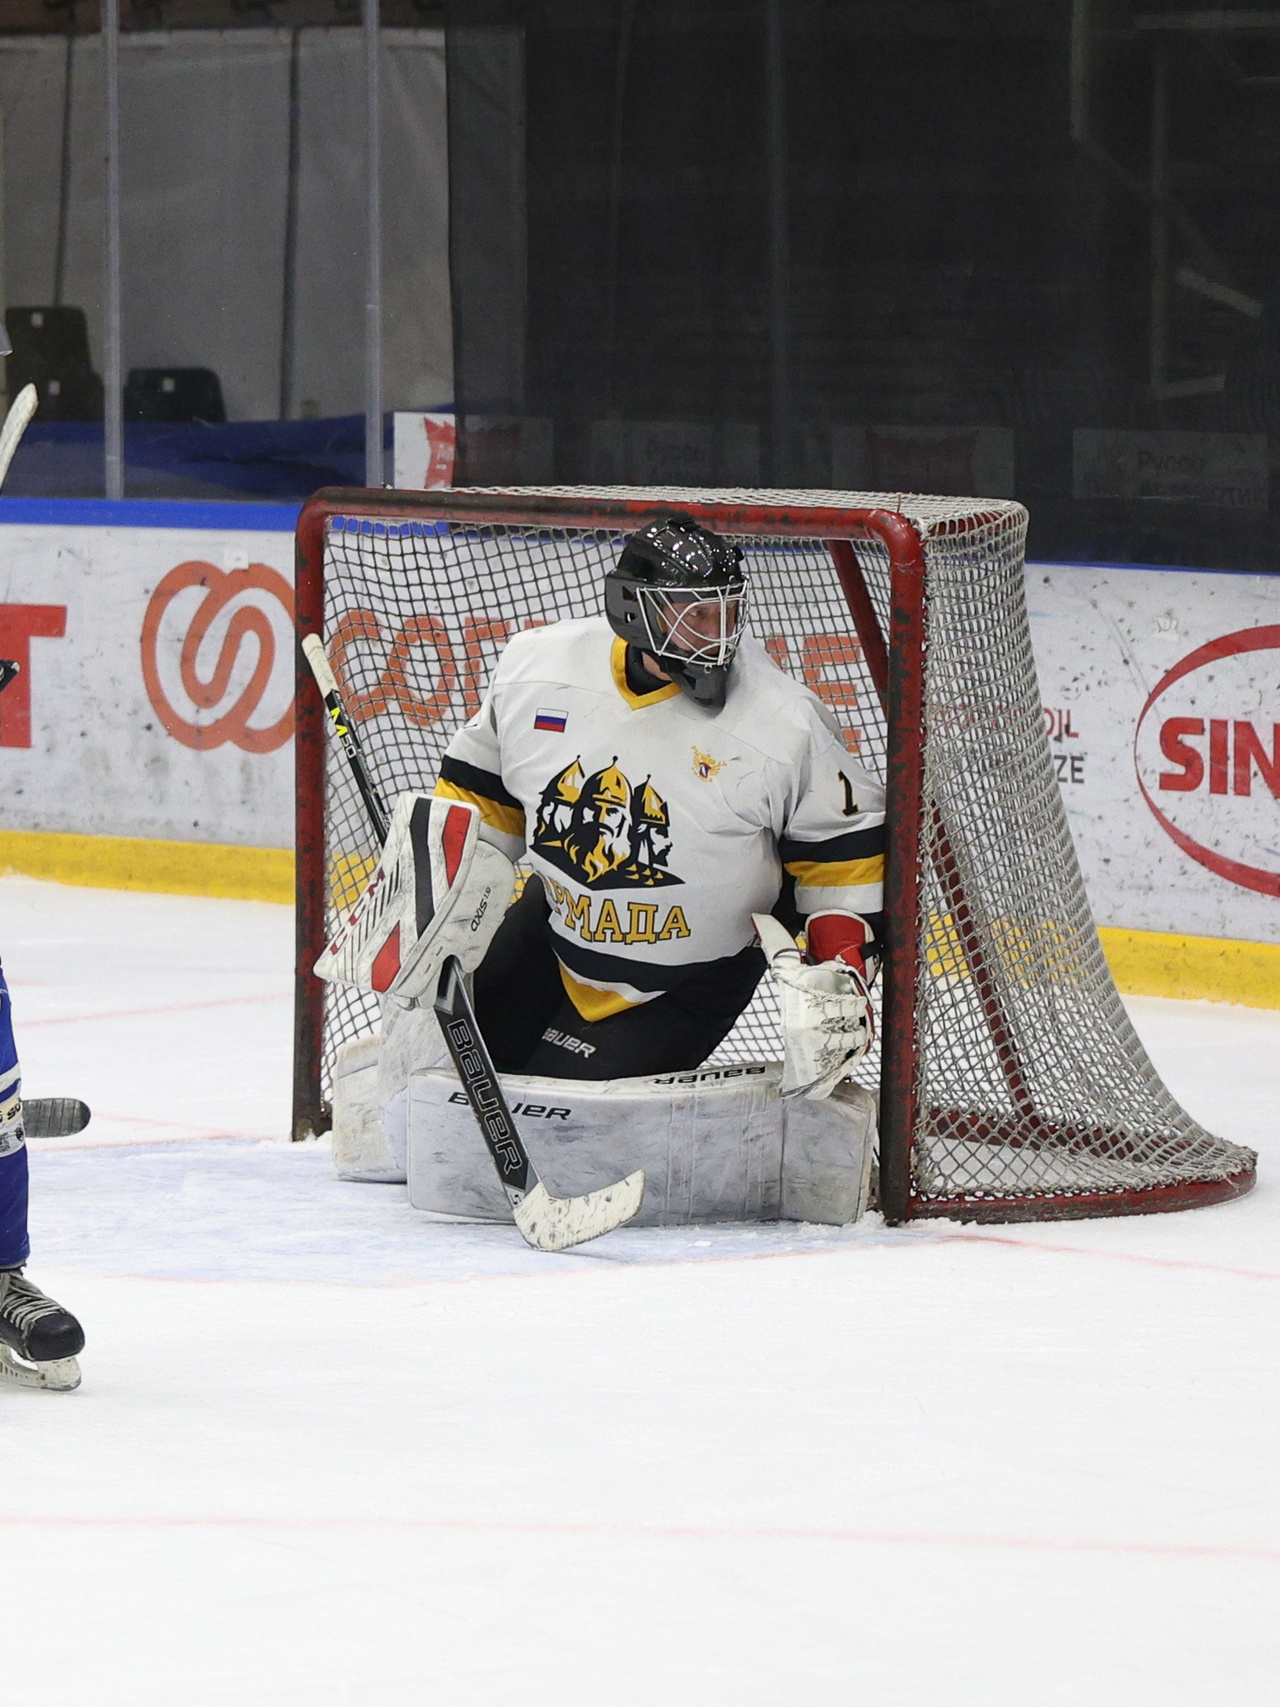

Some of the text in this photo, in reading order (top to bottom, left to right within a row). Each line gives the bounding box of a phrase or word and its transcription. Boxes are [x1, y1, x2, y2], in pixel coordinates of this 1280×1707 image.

[837, 769, 859, 817] 1
[447, 1018, 523, 1176] BAUER
[448, 1091, 572, 1121] BER
